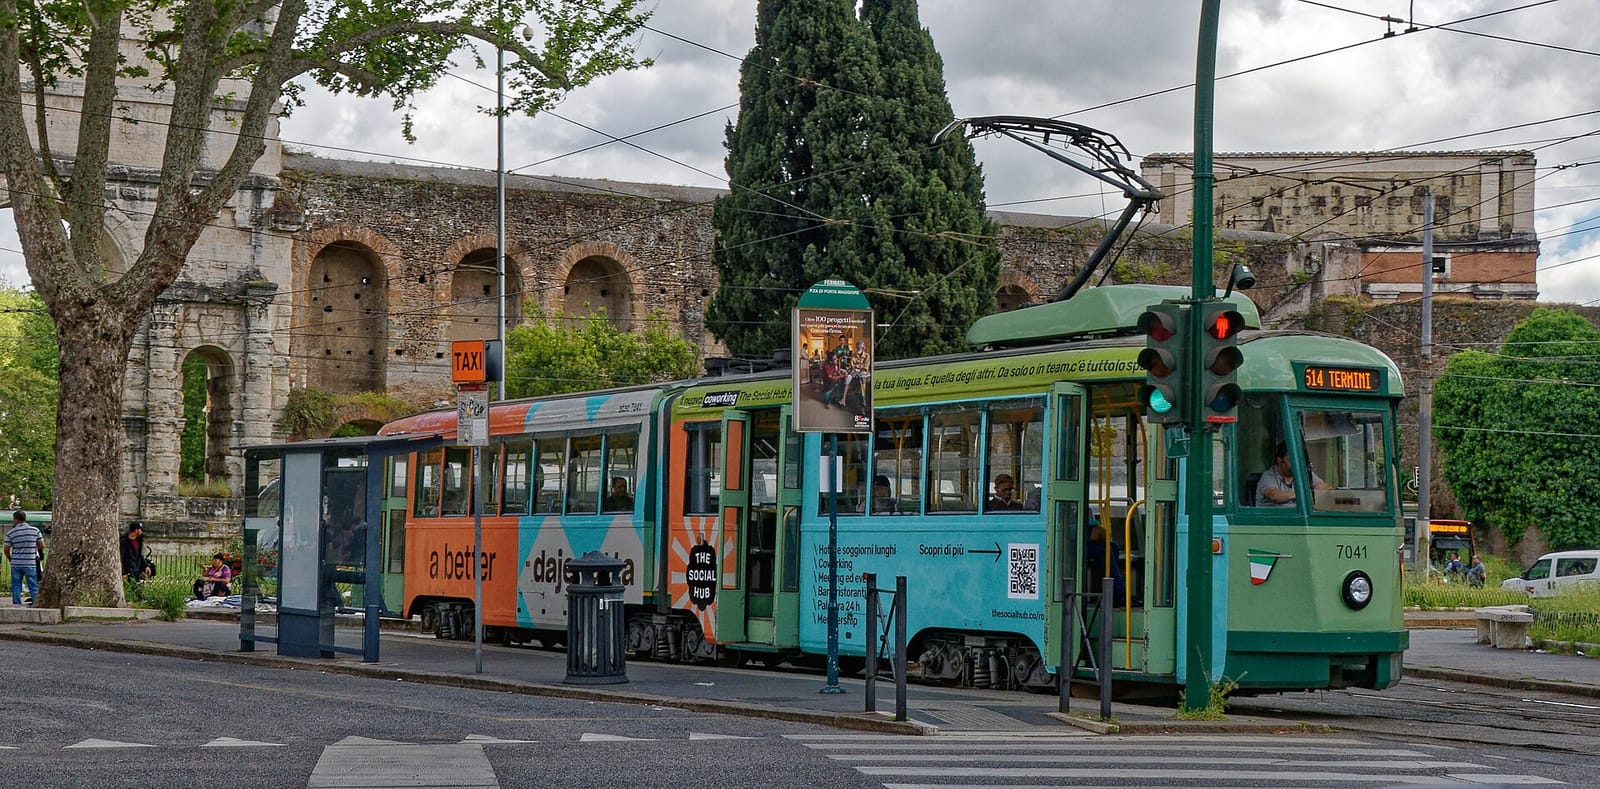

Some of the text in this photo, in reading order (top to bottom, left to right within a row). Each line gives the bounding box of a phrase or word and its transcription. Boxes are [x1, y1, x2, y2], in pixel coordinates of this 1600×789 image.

[827, 316, 851, 325] progetti
[454, 351, 482, 371] TAXI
[873, 379, 881, 390] la
[882, 379, 896, 389] tua
[896, 376, 922, 390] lingua.
[924, 374, 931, 385] E
[931, 372, 955, 387] quella
[956, 369, 976, 384] degli
[998, 367, 1010, 378] Da
[1010, 365, 1028, 377] solo
[1036, 363, 1045, 374] in
[1305, 369, 1372, 390] 514 TERMINI
[703, 392, 738, 405] coworking
[740, 391, 752, 401] The
[752, 389, 772, 401] Social
[773, 387, 788, 399] Hub
[842, 544, 874, 557] soggiorni
[875, 544, 897, 557] lunghi
[919, 544, 964, 557] Scopri di più
[1336, 544, 1367, 559] 7041
[695, 551, 711, 564] THE
[430, 550, 438, 579] a
[445, 543, 496, 581] better
[533, 548, 576, 593] daje
[688, 569, 717, 581] SOCIAL
[845, 573, 854, 583] ed
[693, 586, 710, 600] HUB
[846, 601, 854, 611] 24
[856, 601, 861, 611] h
